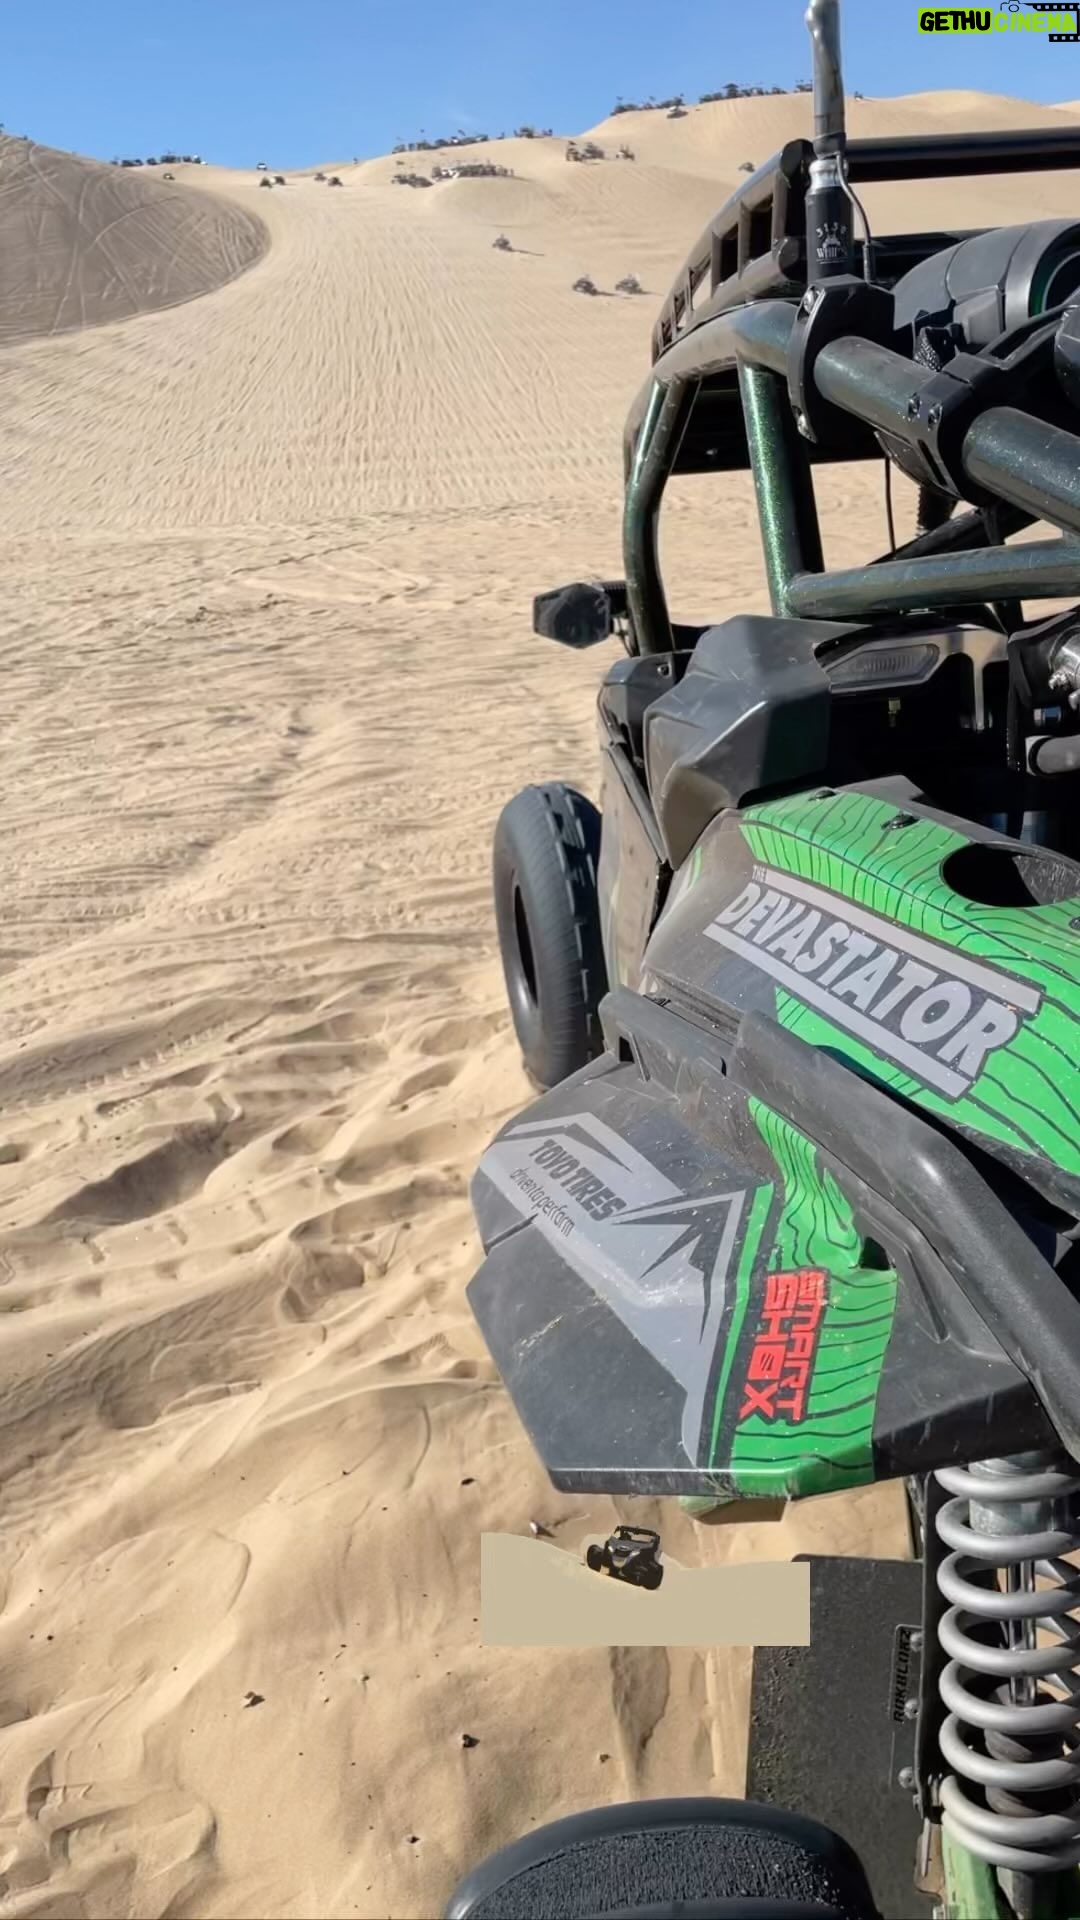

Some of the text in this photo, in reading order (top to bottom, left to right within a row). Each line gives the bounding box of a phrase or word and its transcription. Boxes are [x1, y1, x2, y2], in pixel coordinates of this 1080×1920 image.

[714, 882, 1019, 1079] DEVASTATOR
[528, 1138, 627, 1222] TOYO TIRES
